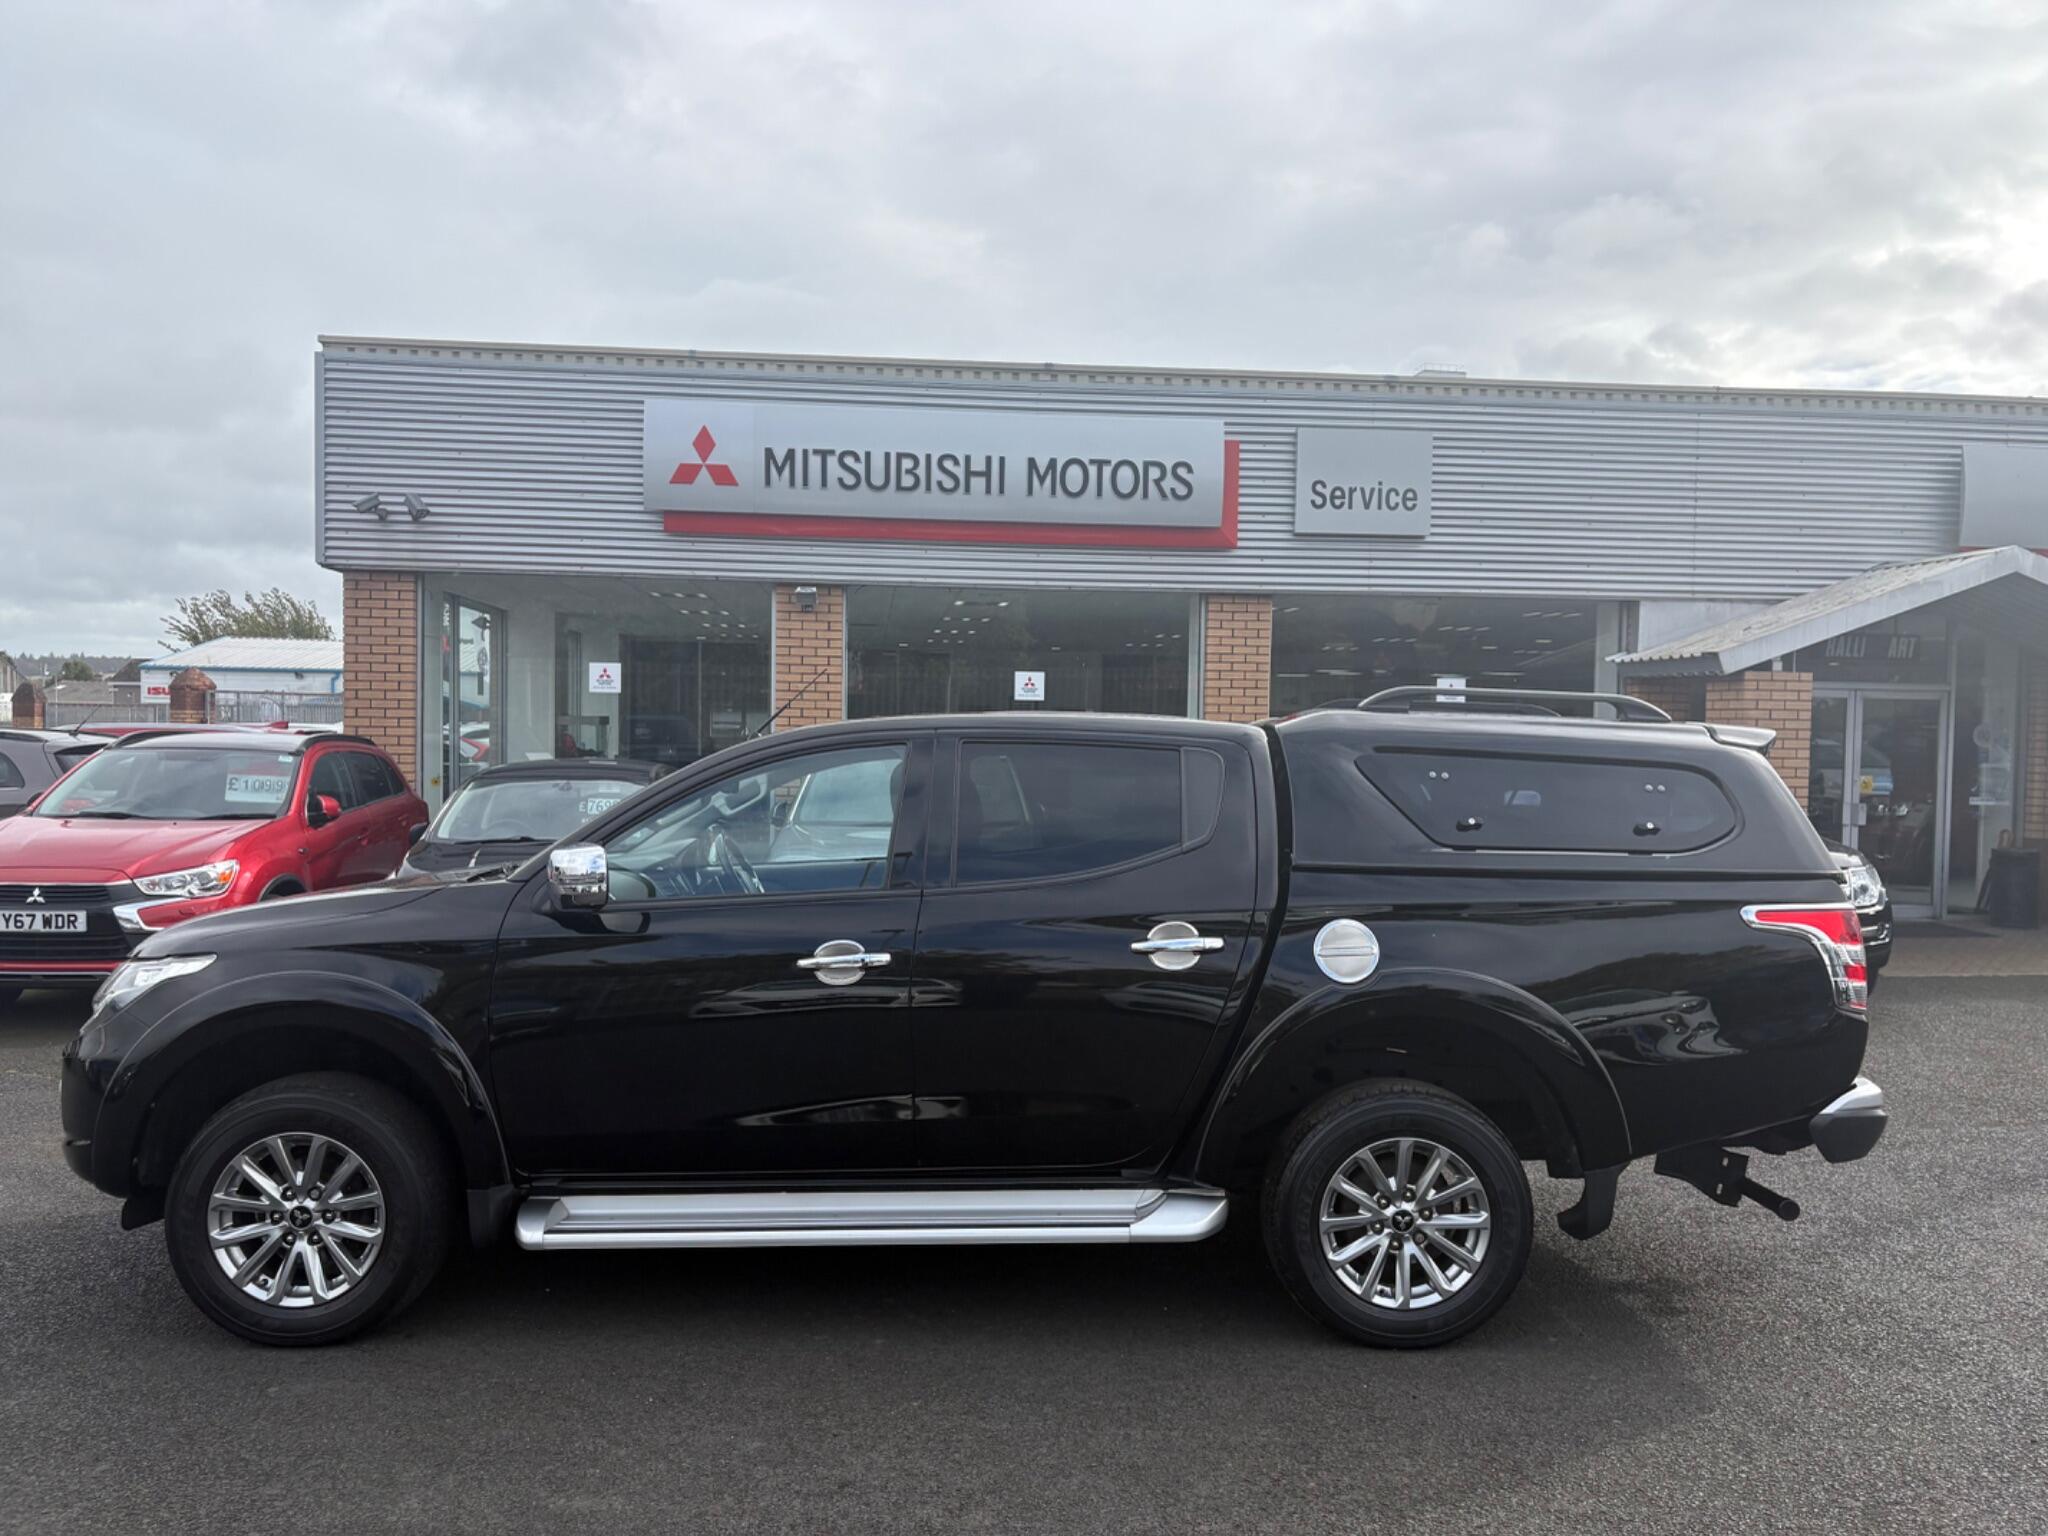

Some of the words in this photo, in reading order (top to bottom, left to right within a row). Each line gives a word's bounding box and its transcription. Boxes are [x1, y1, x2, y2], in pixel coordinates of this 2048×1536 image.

[764, 447, 1005, 494] MITSUBISHI
[1027, 457, 1194, 500] MOTORS
[1310, 479, 1418, 511] Service
[42, 913, 78, 929] WDR
